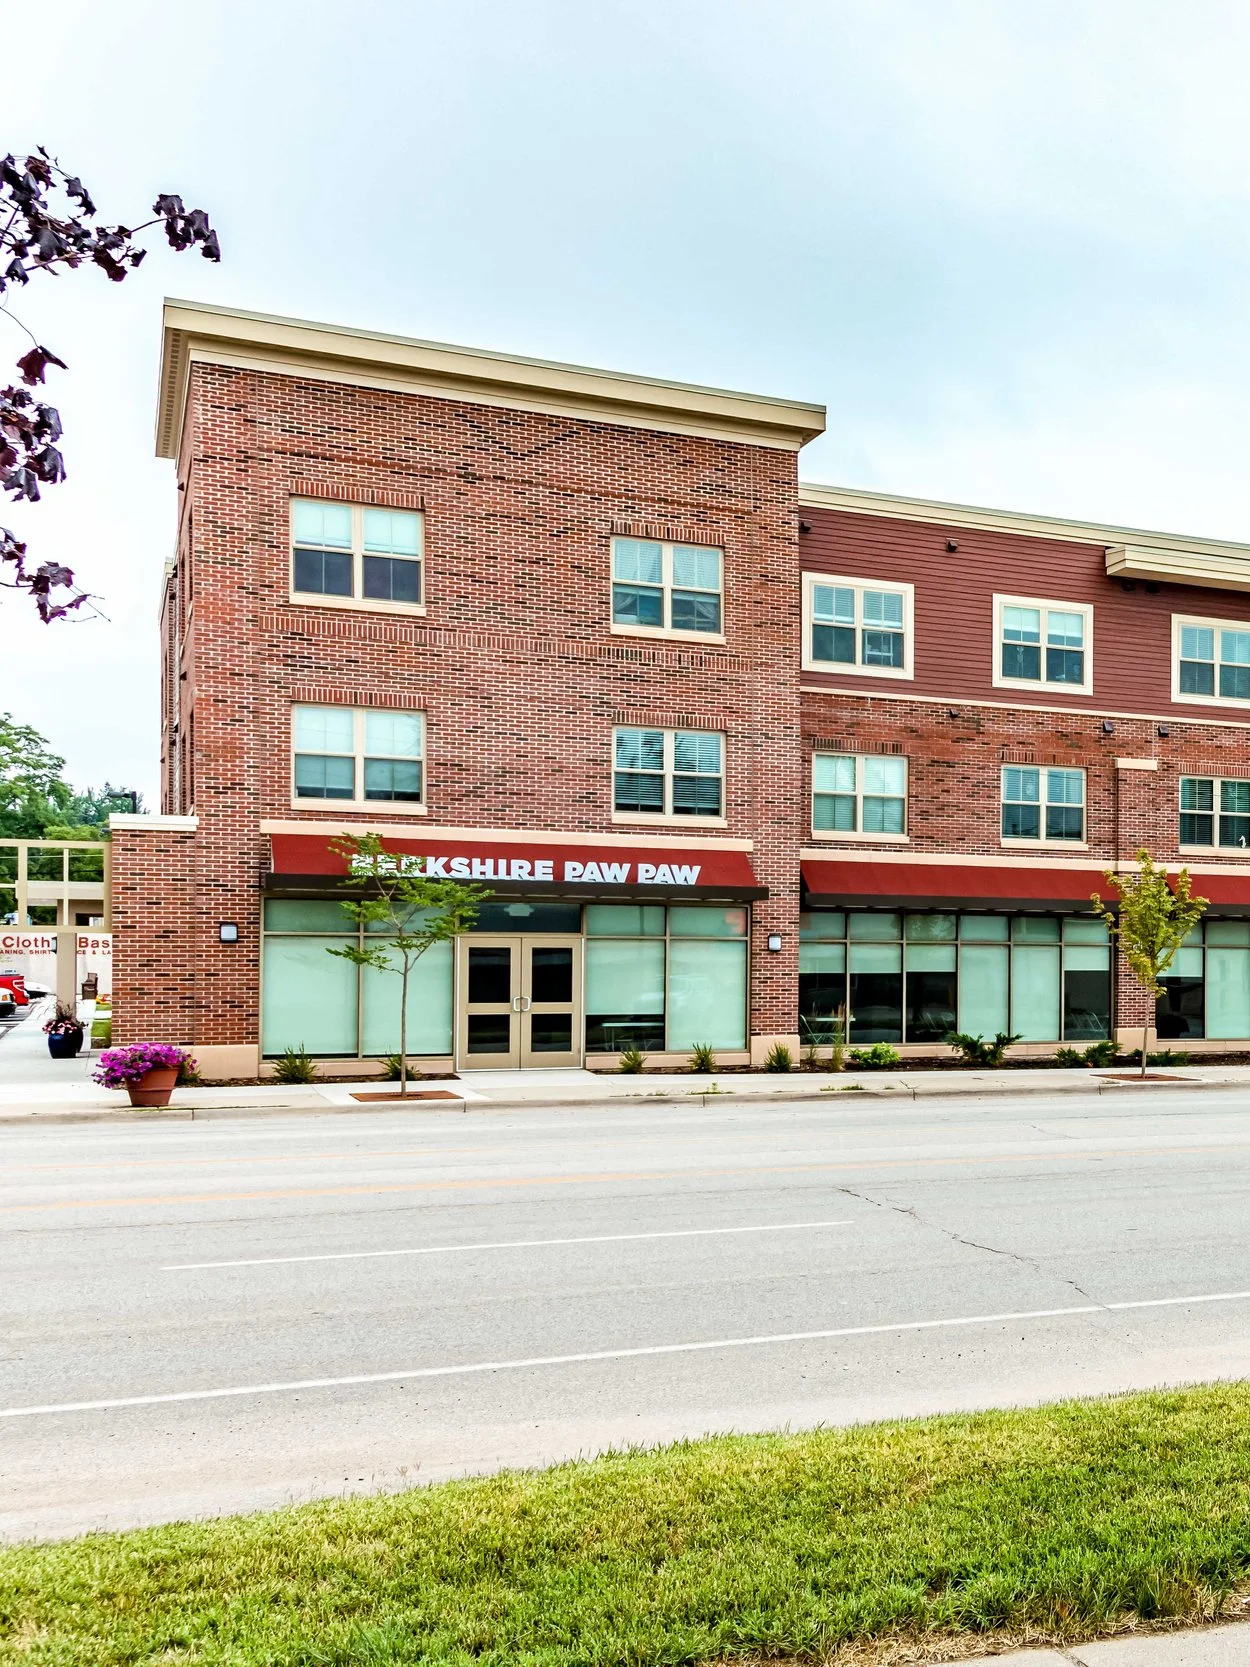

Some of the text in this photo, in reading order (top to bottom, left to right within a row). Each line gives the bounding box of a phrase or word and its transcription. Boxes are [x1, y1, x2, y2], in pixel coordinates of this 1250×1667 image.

[564, 861, 632, 883] PAW
[637, 863, 702, 885] PAW
[2, 936, 50, 948] Cloth
